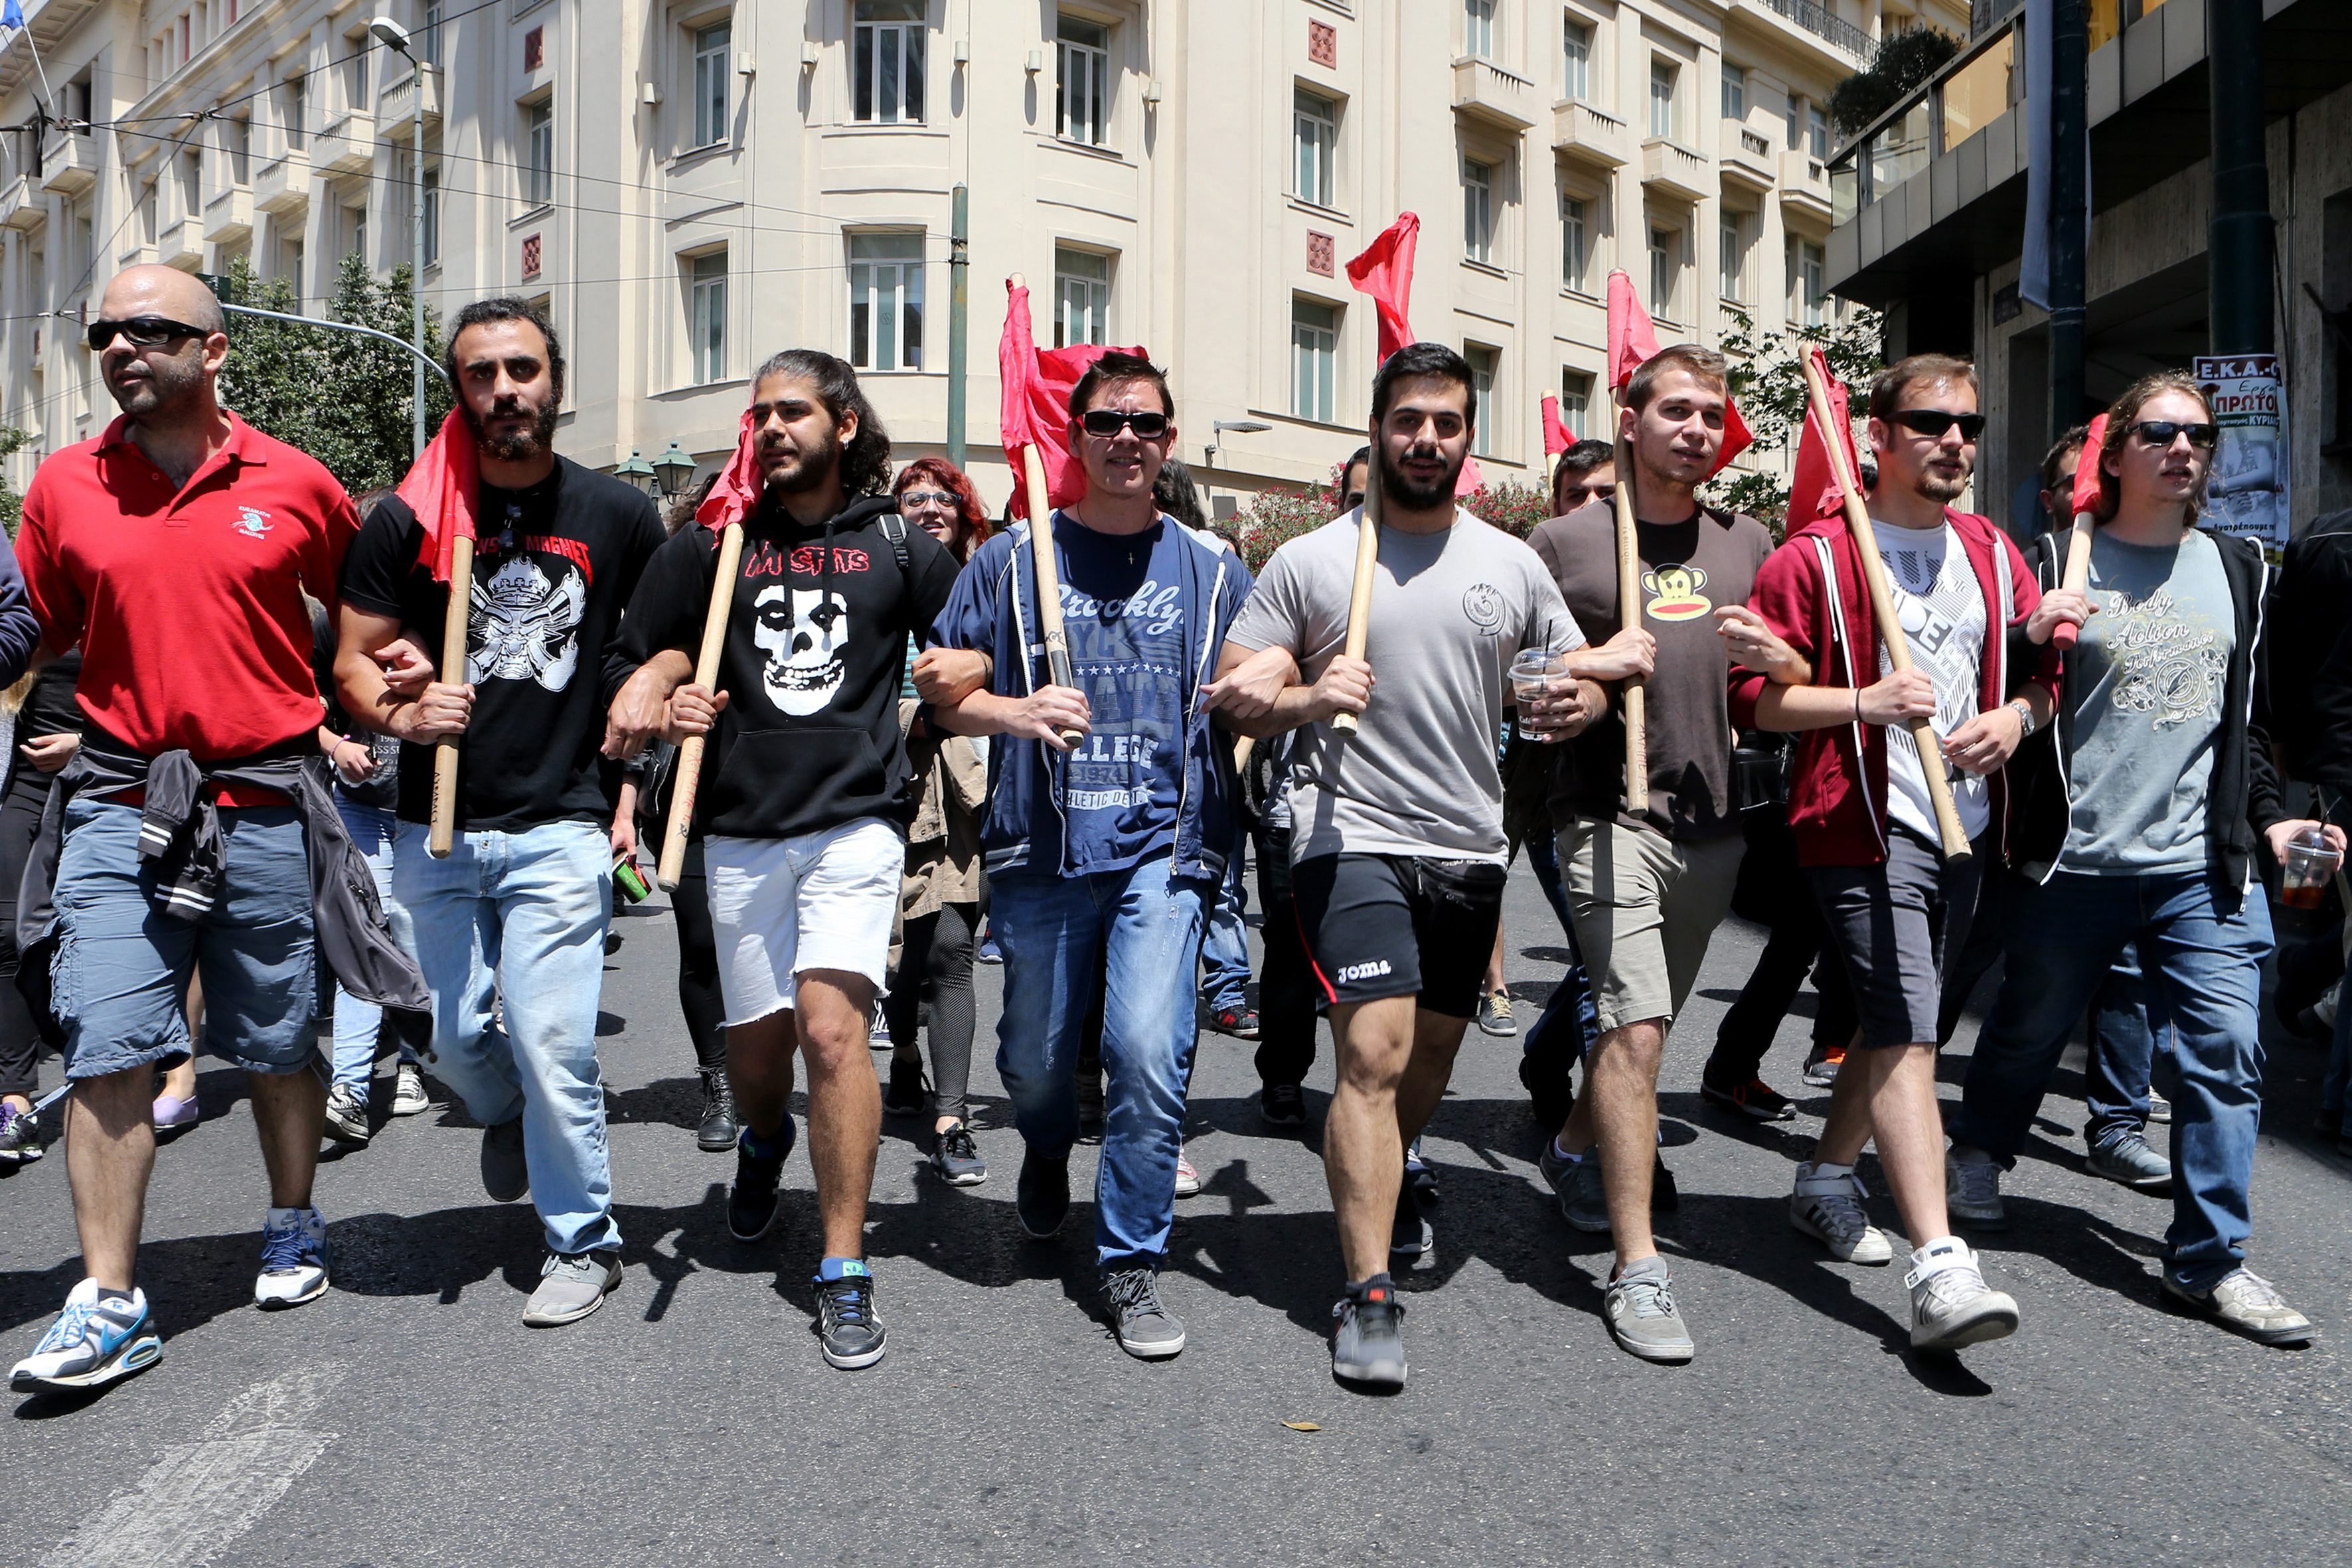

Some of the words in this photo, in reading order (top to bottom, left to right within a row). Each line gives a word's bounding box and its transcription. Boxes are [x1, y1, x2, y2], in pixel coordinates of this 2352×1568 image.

[2215, 394, 2278, 412] ΠΡΩΤΟ
[2106, 588, 2173, 618] Body
[2106, 619, 2189, 651] Action
[1081, 768, 1123, 781] 1974
